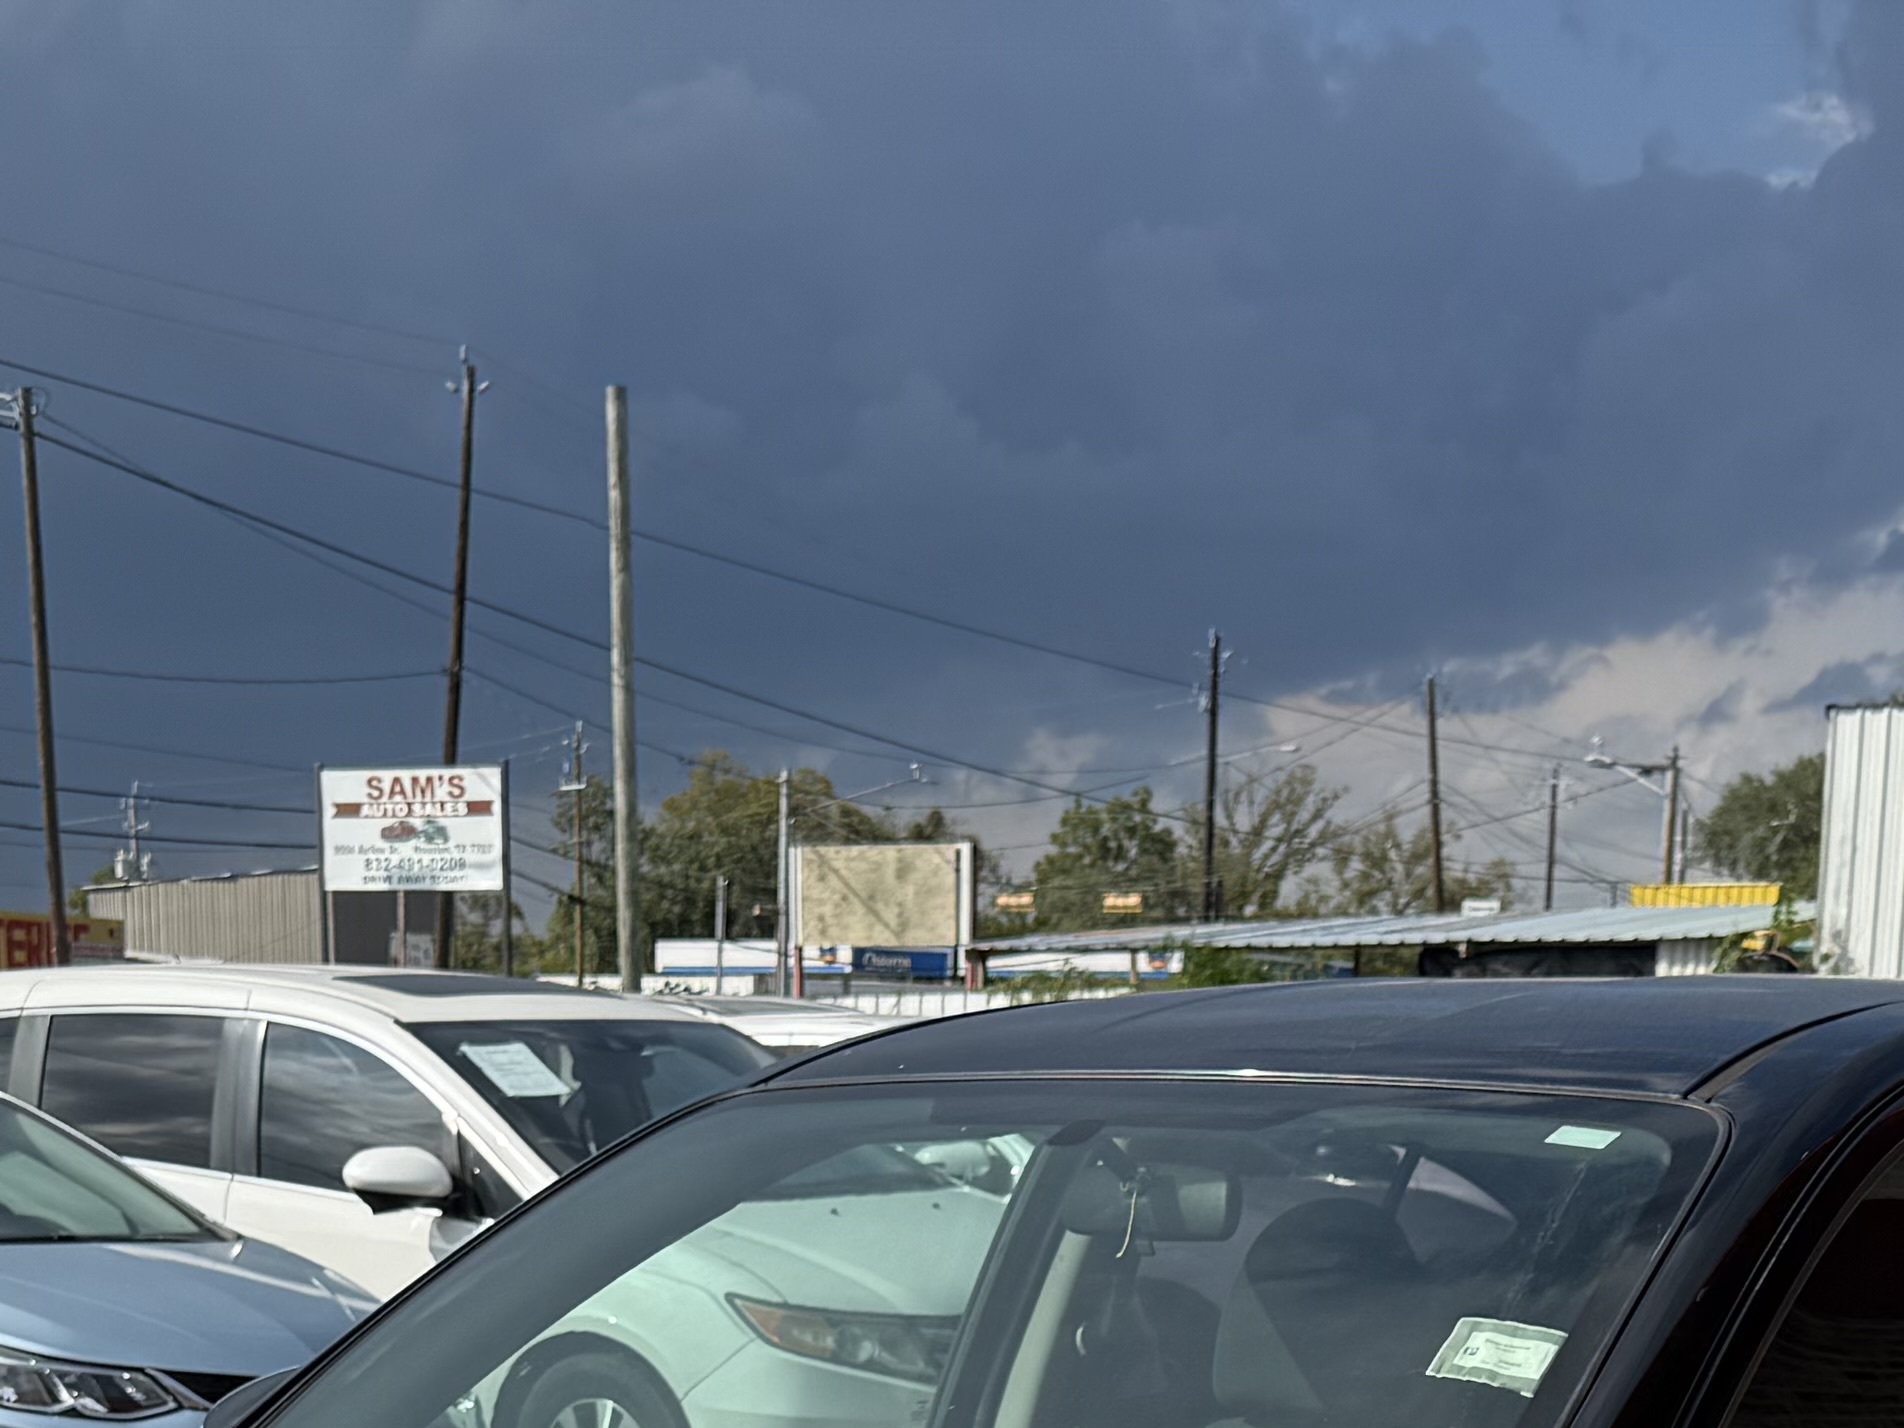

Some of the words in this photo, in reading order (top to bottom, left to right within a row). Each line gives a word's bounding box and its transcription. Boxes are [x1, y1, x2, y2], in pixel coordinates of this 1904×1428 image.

[366, 775, 466, 801] SAM'S
[359, 803, 409, 817] AUTO
[411, 802, 469, 817] SALES
